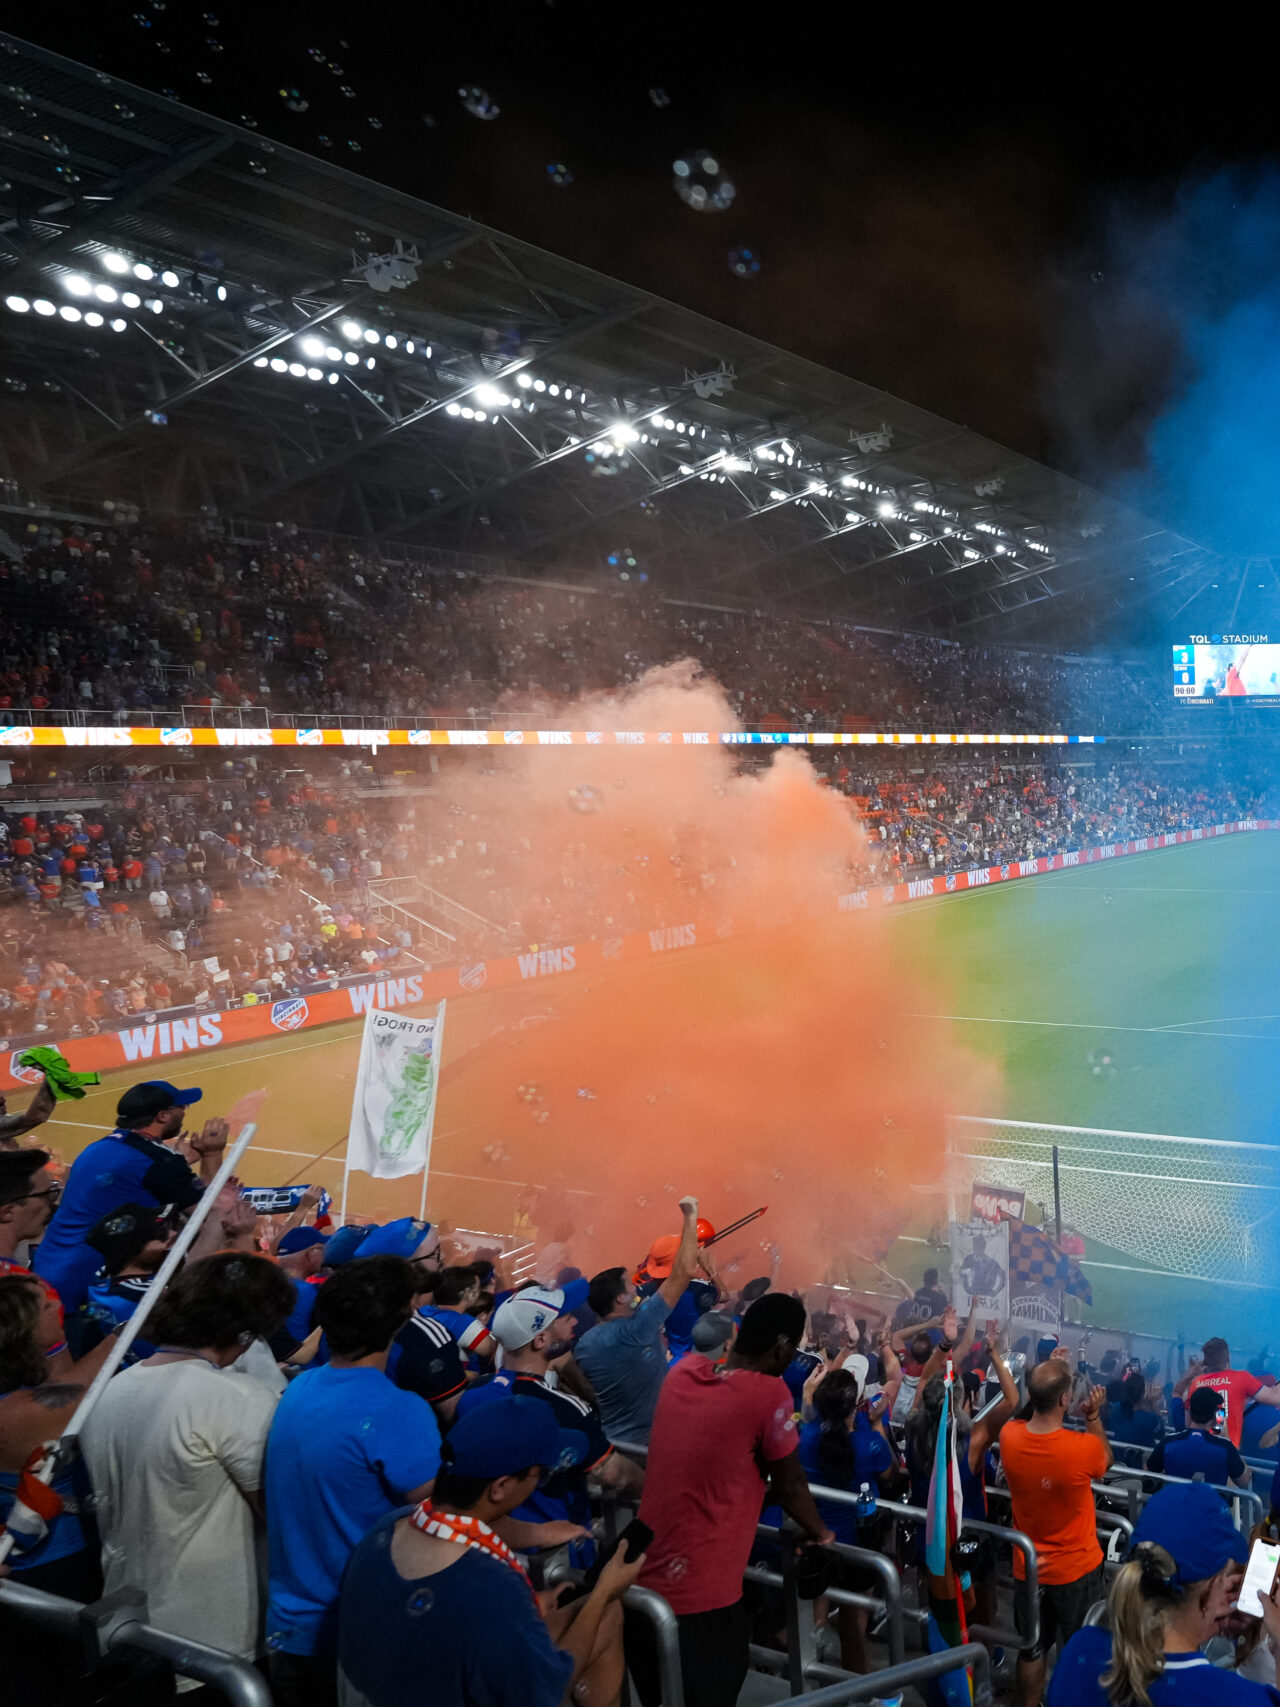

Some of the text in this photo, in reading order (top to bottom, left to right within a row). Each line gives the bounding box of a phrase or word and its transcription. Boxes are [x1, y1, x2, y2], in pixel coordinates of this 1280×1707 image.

[1189, 634, 1269, 644] TQL STADIUM
[1181, 651, 1189, 664] 3
[1175, 686, 1196, 695] 90:00
[62, 727, 133, 746] WINS
[214, 727, 274, 746] WINS
[341, 729, 390, 746] WINS
[447, 730, 489, 745] WINS
[536, 731, 573, 745] WINS
[614, 731, 646, 745] WINS
[682, 731, 710, 745] WINS
[1237, 819, 1259, 831] WINS
[1062, 851, 1080, 865] WINS
[1101, 841, 1116, 858] WINS
[1019, 859, 1039, 877] WINS
[967, 868, 990, 887] WINS
[908, 878, 934, 899] WINS
[649, 923, 696, 952] WINS
[518, 946, 576, 979] WINS
[348, 975, 424, 1014] WINS
[119, 1013, 223, 1062] WINS
[1195, 1376, 1232, 1388] BARREAL
